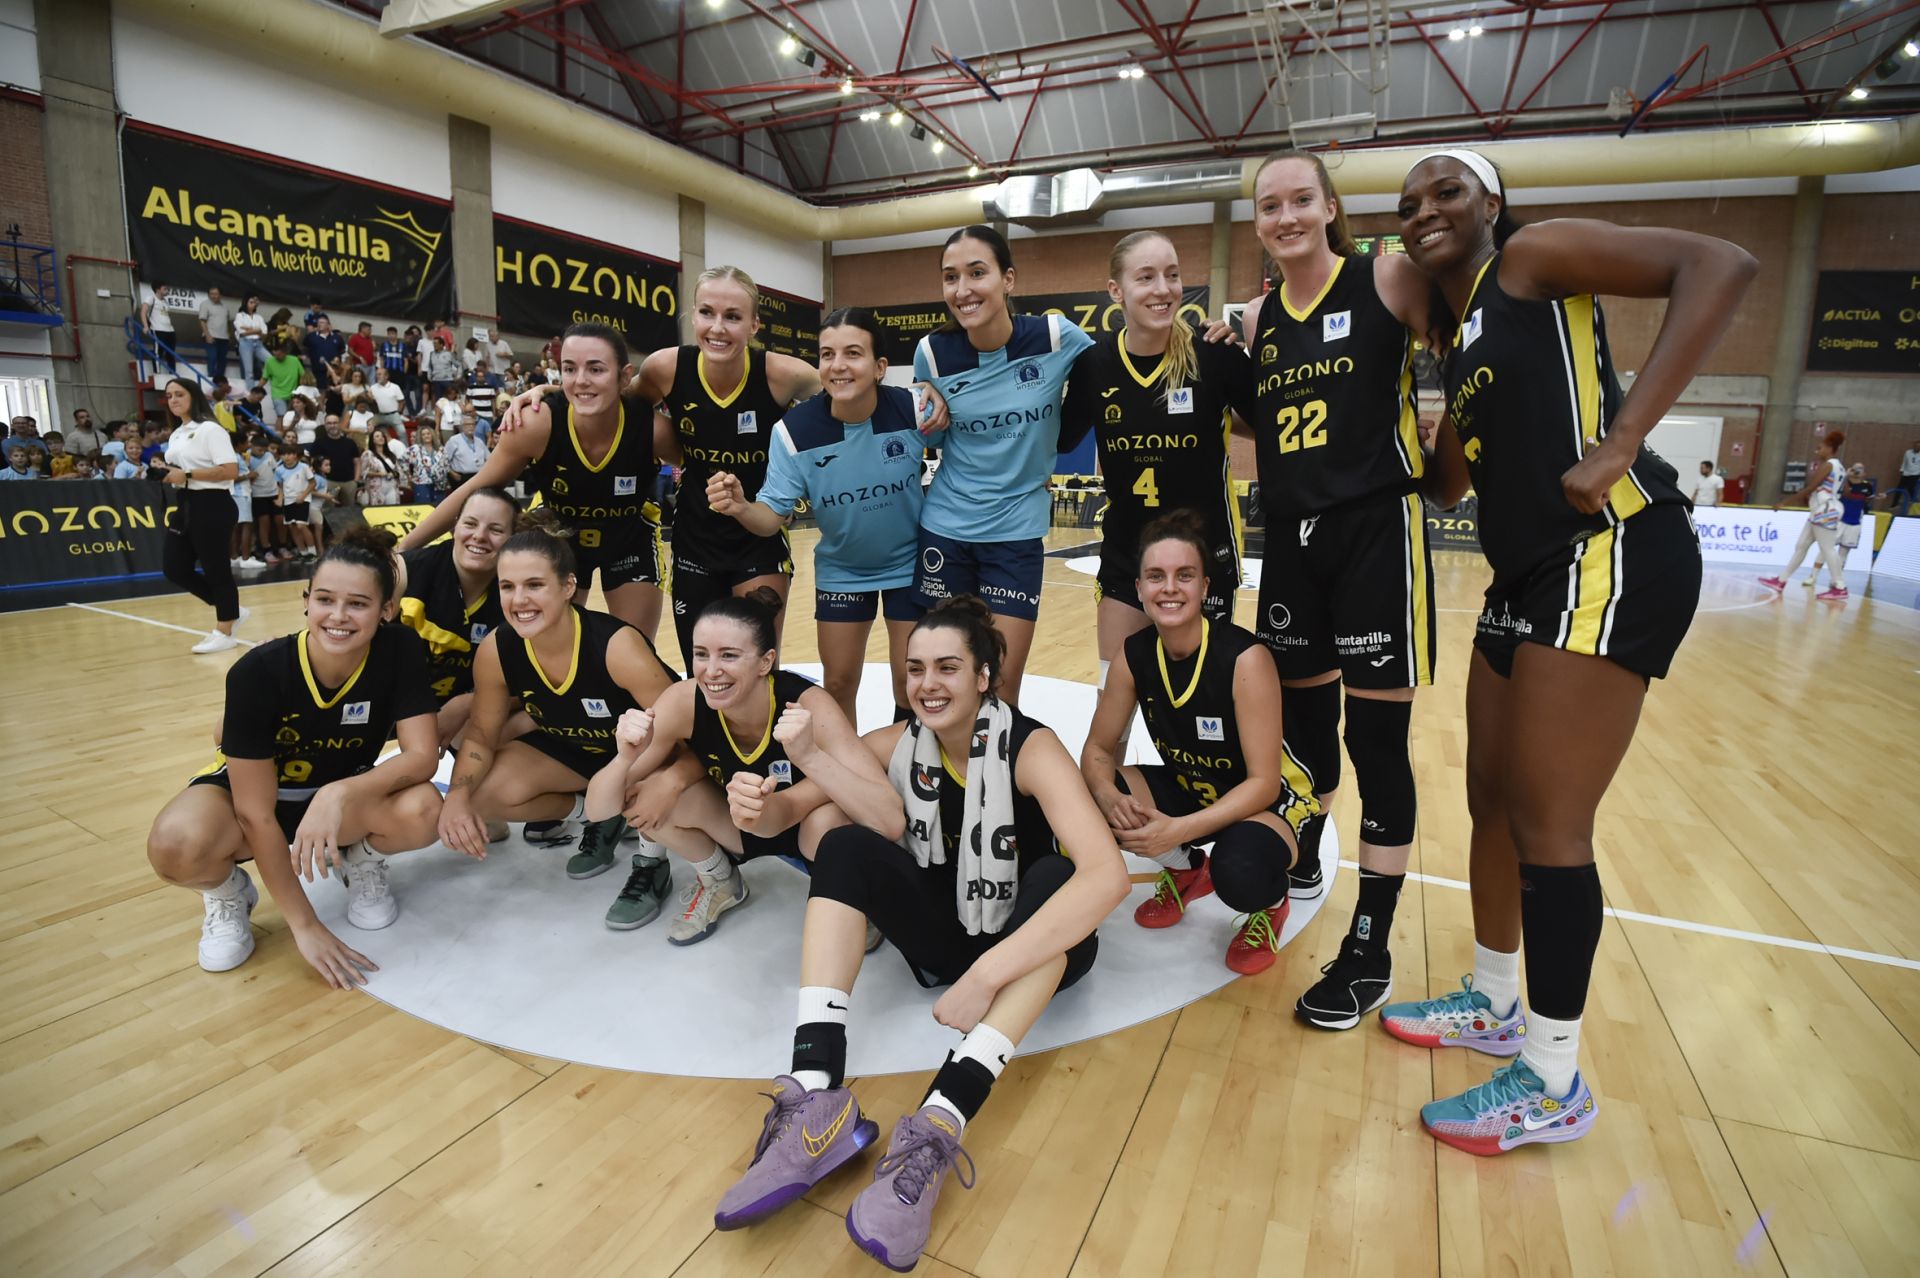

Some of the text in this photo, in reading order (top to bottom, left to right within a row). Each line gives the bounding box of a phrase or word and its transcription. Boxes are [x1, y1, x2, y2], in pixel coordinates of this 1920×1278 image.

[142, 186, 391, 262] Alcantarilla
[189, 236, 367, 277] donde la huerta nace
[496, 246, 676, 316] HOZONO
[167, 297, 194, 309] ESTE
[758, 295, 787, 313] ZONO
[886, 312, 947, 326] ESTRELLA
[1258, 356, 1354, 397] HOZONO
[1284, 386, 1315, 400] GLOBAL
[1277, 399, 1327, 454] 22
[1106, 433, 1198, 452] HOZONO
[683, 444, 766, 464] HOZONO
[1134, 455, 1164, 463] GLOBAL
[1132, 467, 1160, 507] 4
[862, 500, 894, 512] GLOBAL
[0, 505, 178, 538] OZON
[1444, 533, 1476, 541] GLOBAL
[1733, 524, 1752, 541] te
[69, 540, 135, 555] GLOBAL
[818, 593, 864, 602] HOZONO
[980, 585, 1027, 601] HOZONO
[1256, 631, 1274, 642] osta
[280, 760, 312, 782] 9
